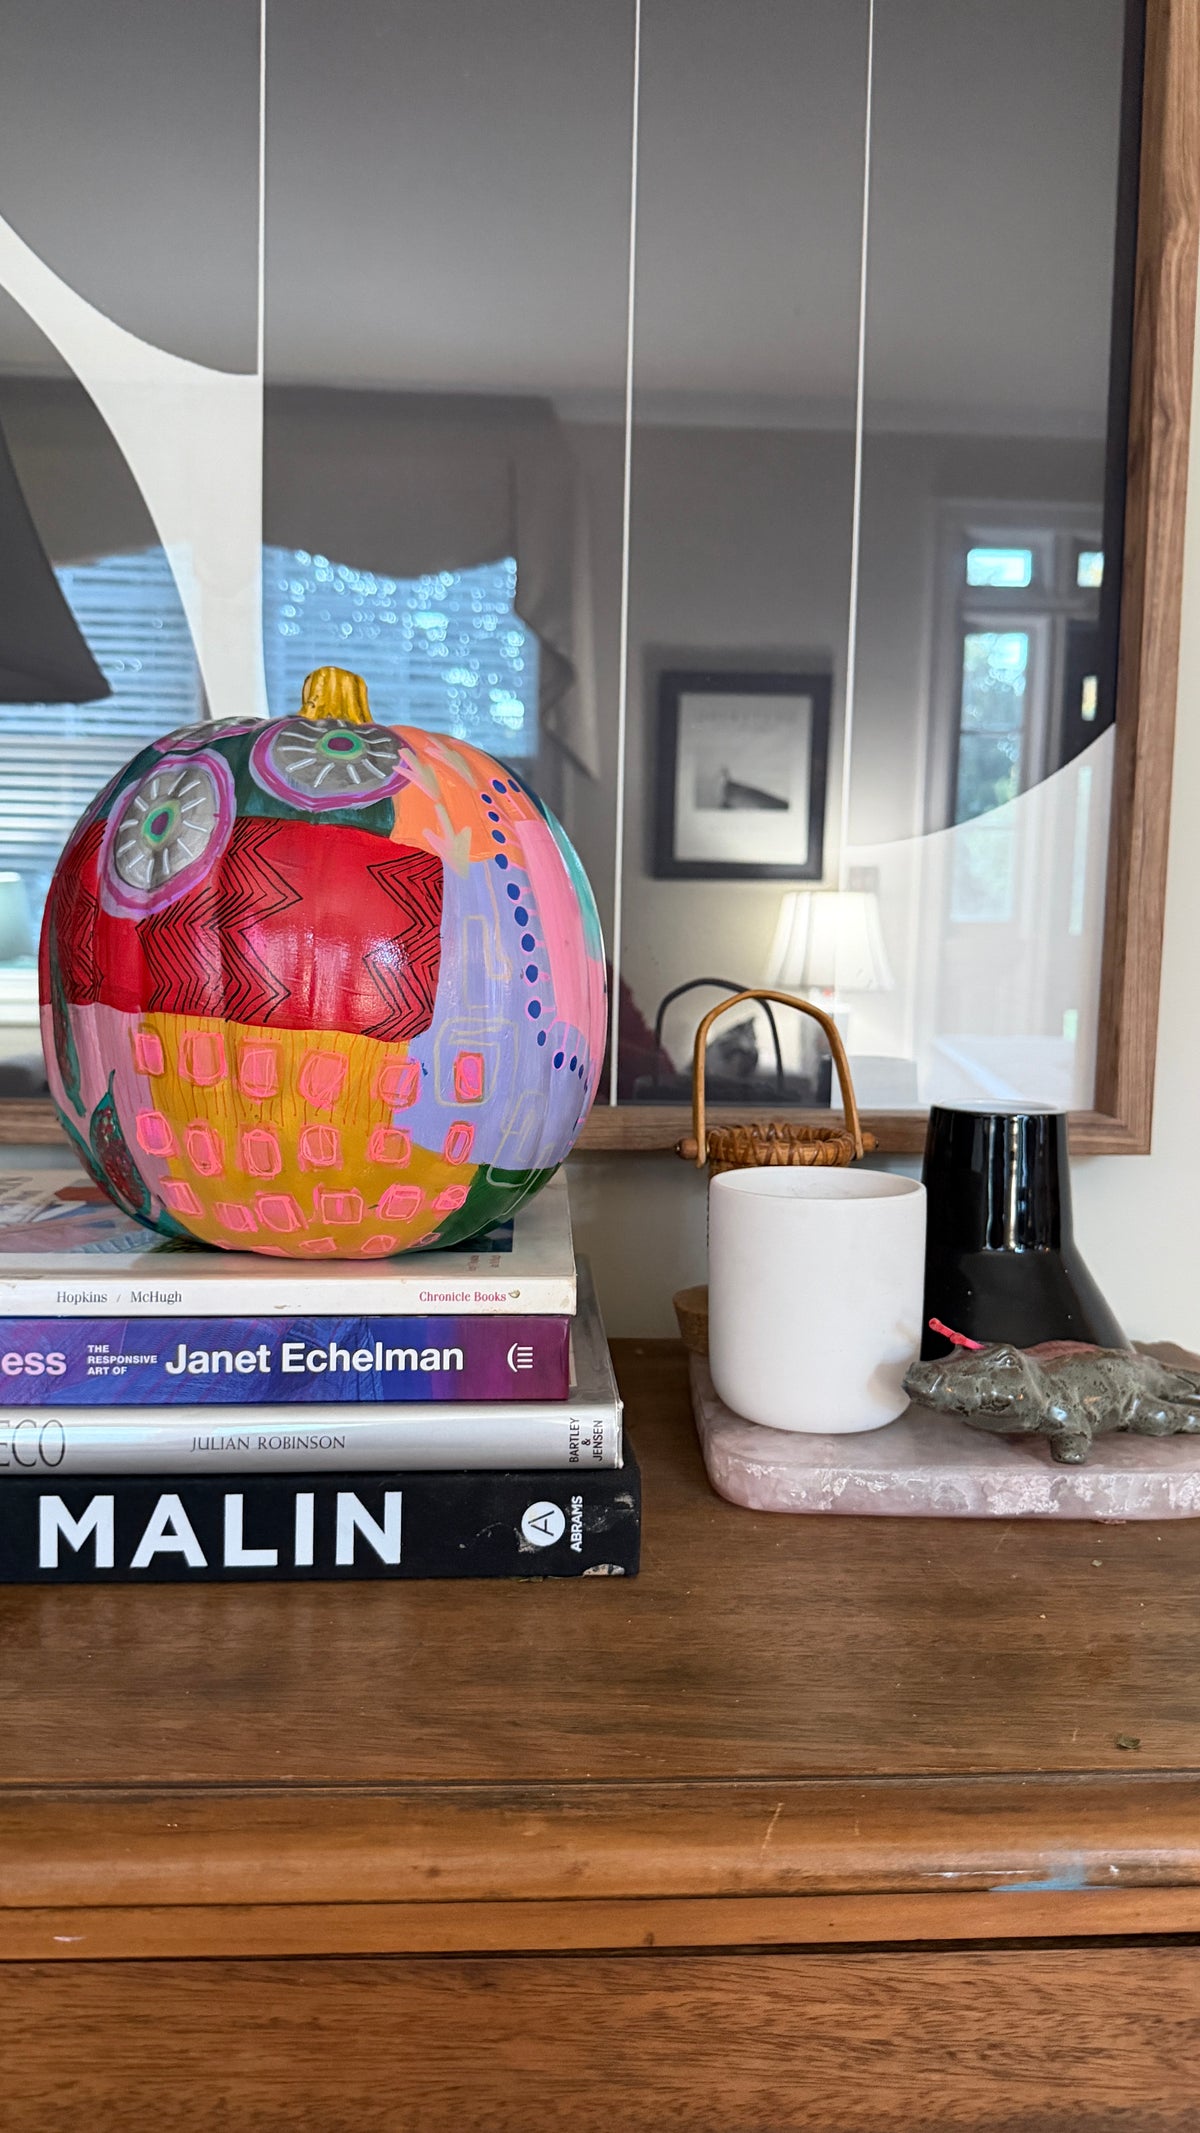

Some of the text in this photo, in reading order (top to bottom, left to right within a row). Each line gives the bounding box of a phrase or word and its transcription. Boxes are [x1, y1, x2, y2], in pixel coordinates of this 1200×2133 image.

[56, 1291, 108, 1305] Hopkins
[130, 1290, 183, 1305] McHugh
[419, 1291, 507, 1302] Chronicle Books
[87, 1344, 110, 1353] THE
[1, 1352, 67, 1376] ess
[87, 1355, 158, 1364] RESPONSIVE
[165, 1341, 464, 1375] Janet Echelman
[87, 1366, 128, 1375] ART OF
[190, 1435, 346, 1451] JULIAN ROBINSON
[569, 1417, 580, 1463] BARTLEY
[581, 1438, 591, 1446] &
[593, 1419, 603, 1462] JENSEN
[38, 1490, 403, 1568] MALIN
[570, 1495, 583, 1553] ABRAMS
